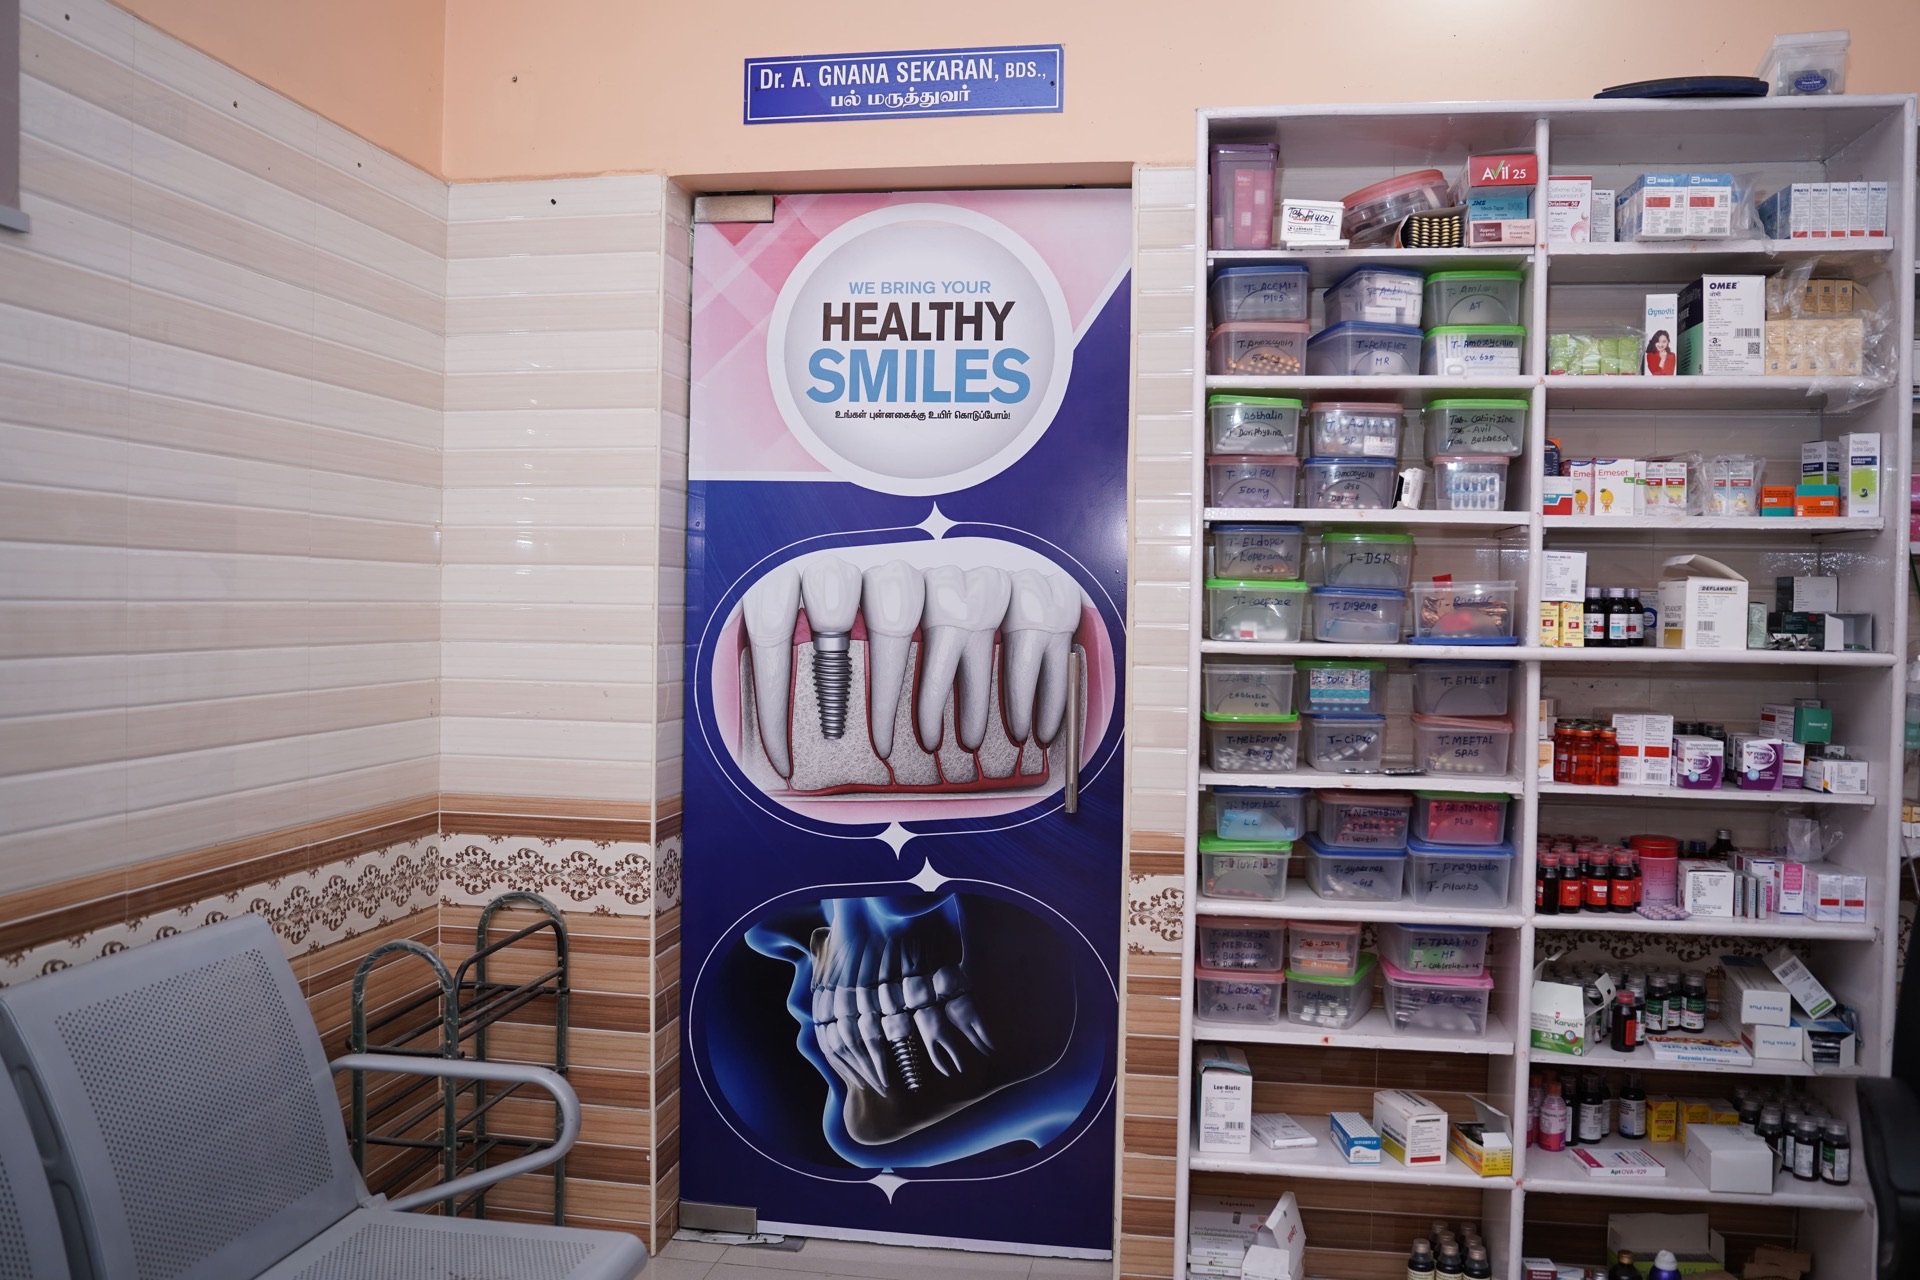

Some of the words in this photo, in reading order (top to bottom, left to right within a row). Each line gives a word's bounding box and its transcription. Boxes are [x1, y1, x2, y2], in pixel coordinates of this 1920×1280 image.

[760, 68, 785, 90] Dr.
[791, 67, 811, 88] A.
[818, 62, 889, 87] GNANA
[896, 58, 1000, 84] SEKARAN,
[1005, 62, 1047, 80] BDS.,
[830, 91, 861, 108] பல்
[868, 84, 971, 109] மருத்துவர்
[1513, 169, 1526, 179] 25
[848, 281, 876, 295] WE
[880, 281, 936, 295] BRING
[941, 280, 991, 294] YOUR
[1709, 282, 1738, 290] OMEE
[1647, 308, 1675, 317] Gynovit
[822, 301, 1016, 342] HEALTHY
[806, 347, 1031, 404] SMILES
[834, 410, 867, 420] உங்கள்
[928, 410, 952, 420] உயிர்
[1598, 469, 1629, 477] Emeset
[1554, 1019, 1578, 1028] Karvol
